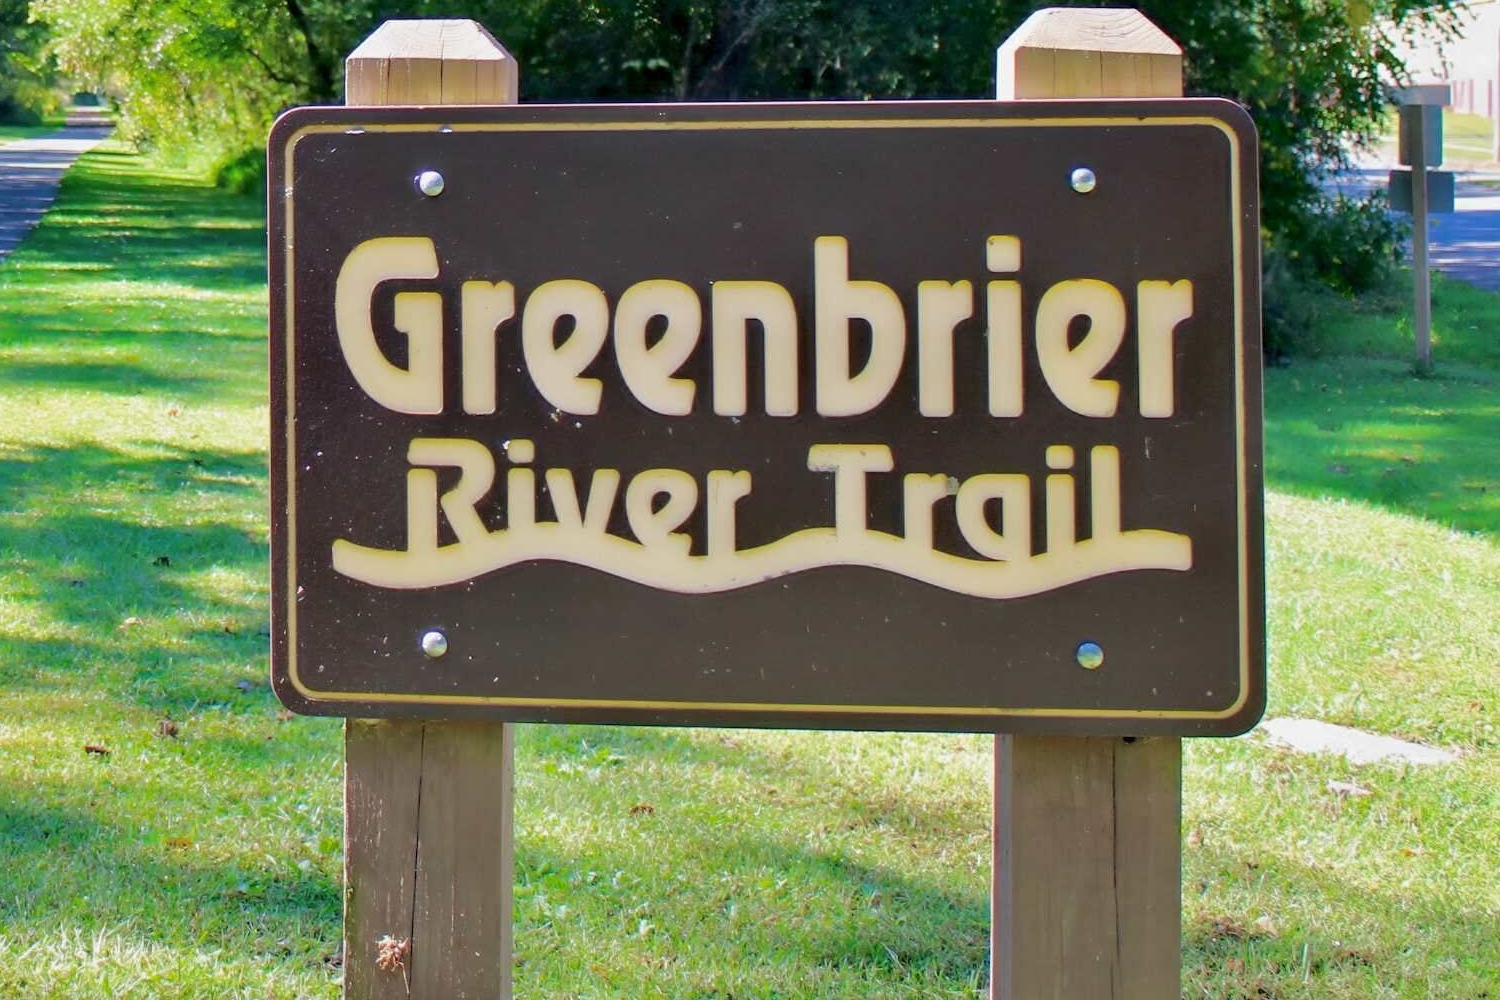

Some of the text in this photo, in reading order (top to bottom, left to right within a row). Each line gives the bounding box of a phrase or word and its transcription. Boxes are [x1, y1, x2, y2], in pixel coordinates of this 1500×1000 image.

[335, 235, 1193, 418] Greenbrier
[406, 438, 1123, 566] River Trail
